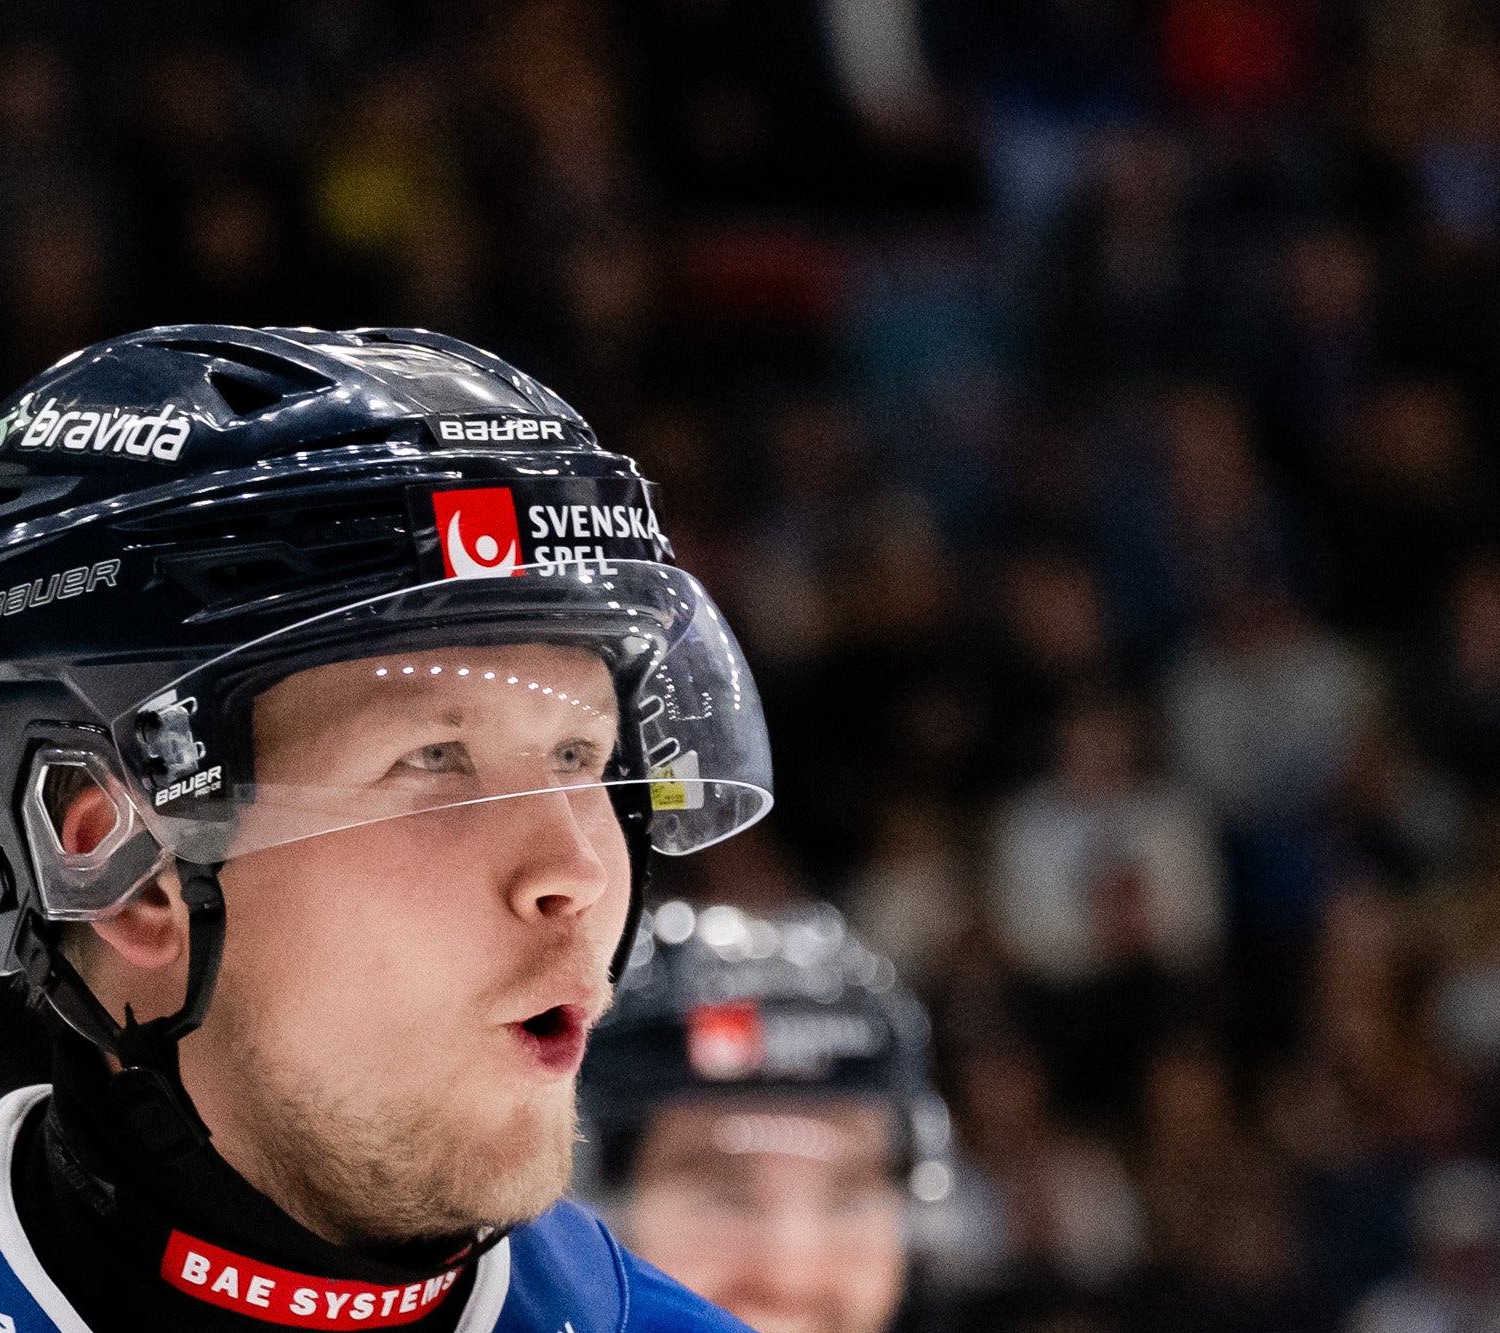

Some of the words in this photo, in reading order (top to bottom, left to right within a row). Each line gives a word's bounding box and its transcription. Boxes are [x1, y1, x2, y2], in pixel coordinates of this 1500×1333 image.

[21, 397, 191, 461] bravida
[439, 419, 565, 441] BAUER
[528, 505, 661, 539] SVENSKA
[534, 546, 618, 577] SPEL
[155, 765, 221, 806] BAUER
[181, 1251, 275, 1308] BAE
